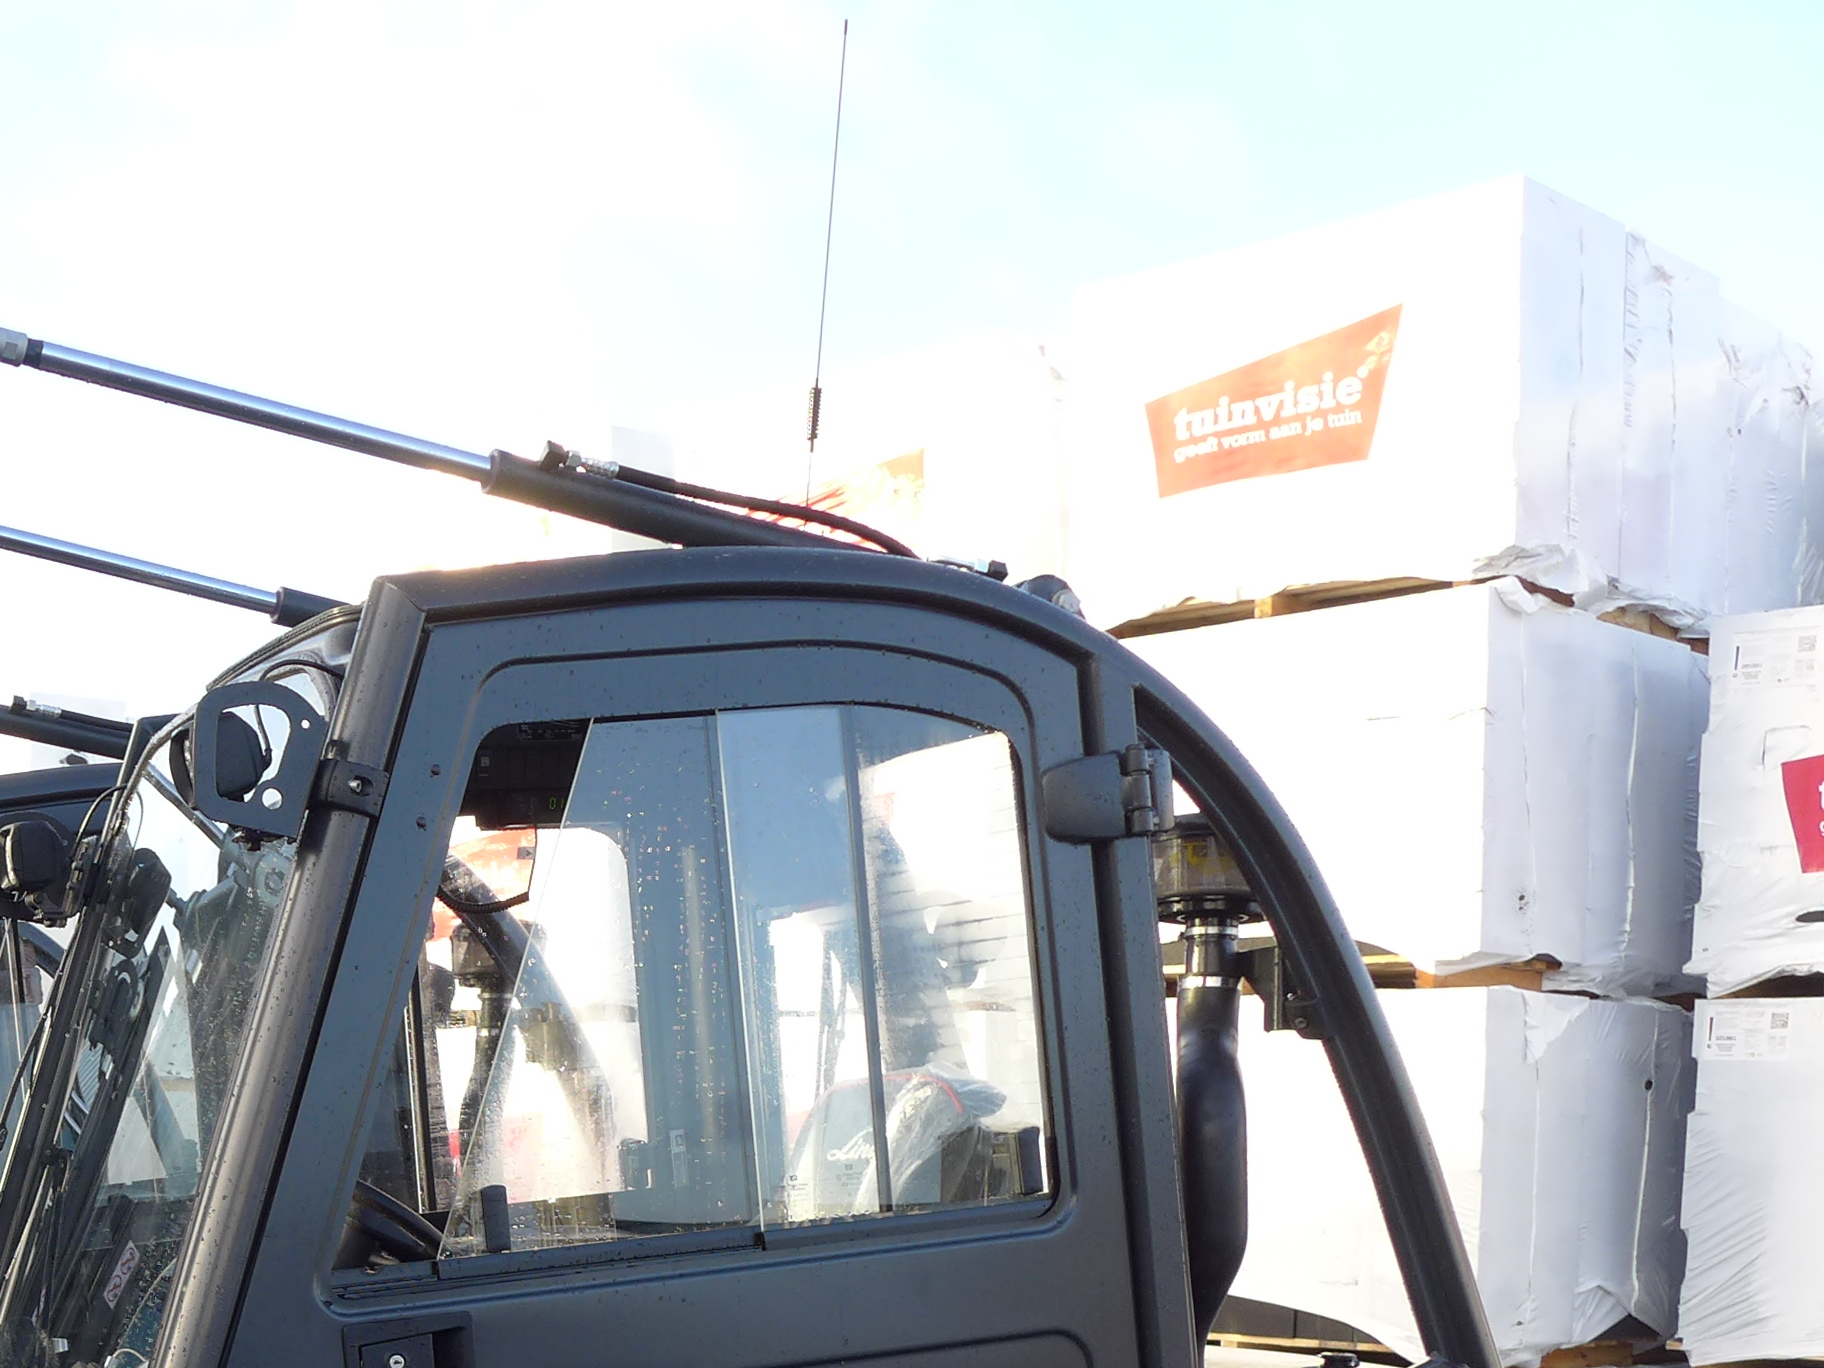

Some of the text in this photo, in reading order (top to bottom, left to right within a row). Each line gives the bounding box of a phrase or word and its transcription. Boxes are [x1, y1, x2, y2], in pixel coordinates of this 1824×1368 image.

[1173, 371, 1363, 441] tuinvisie
[1221, 428, 1267, 450] vorm
[1269, 420, 1303, 441] aan
[1305, 414, 1324, 436] je
[1326, 407, 1363, 429] tuin
